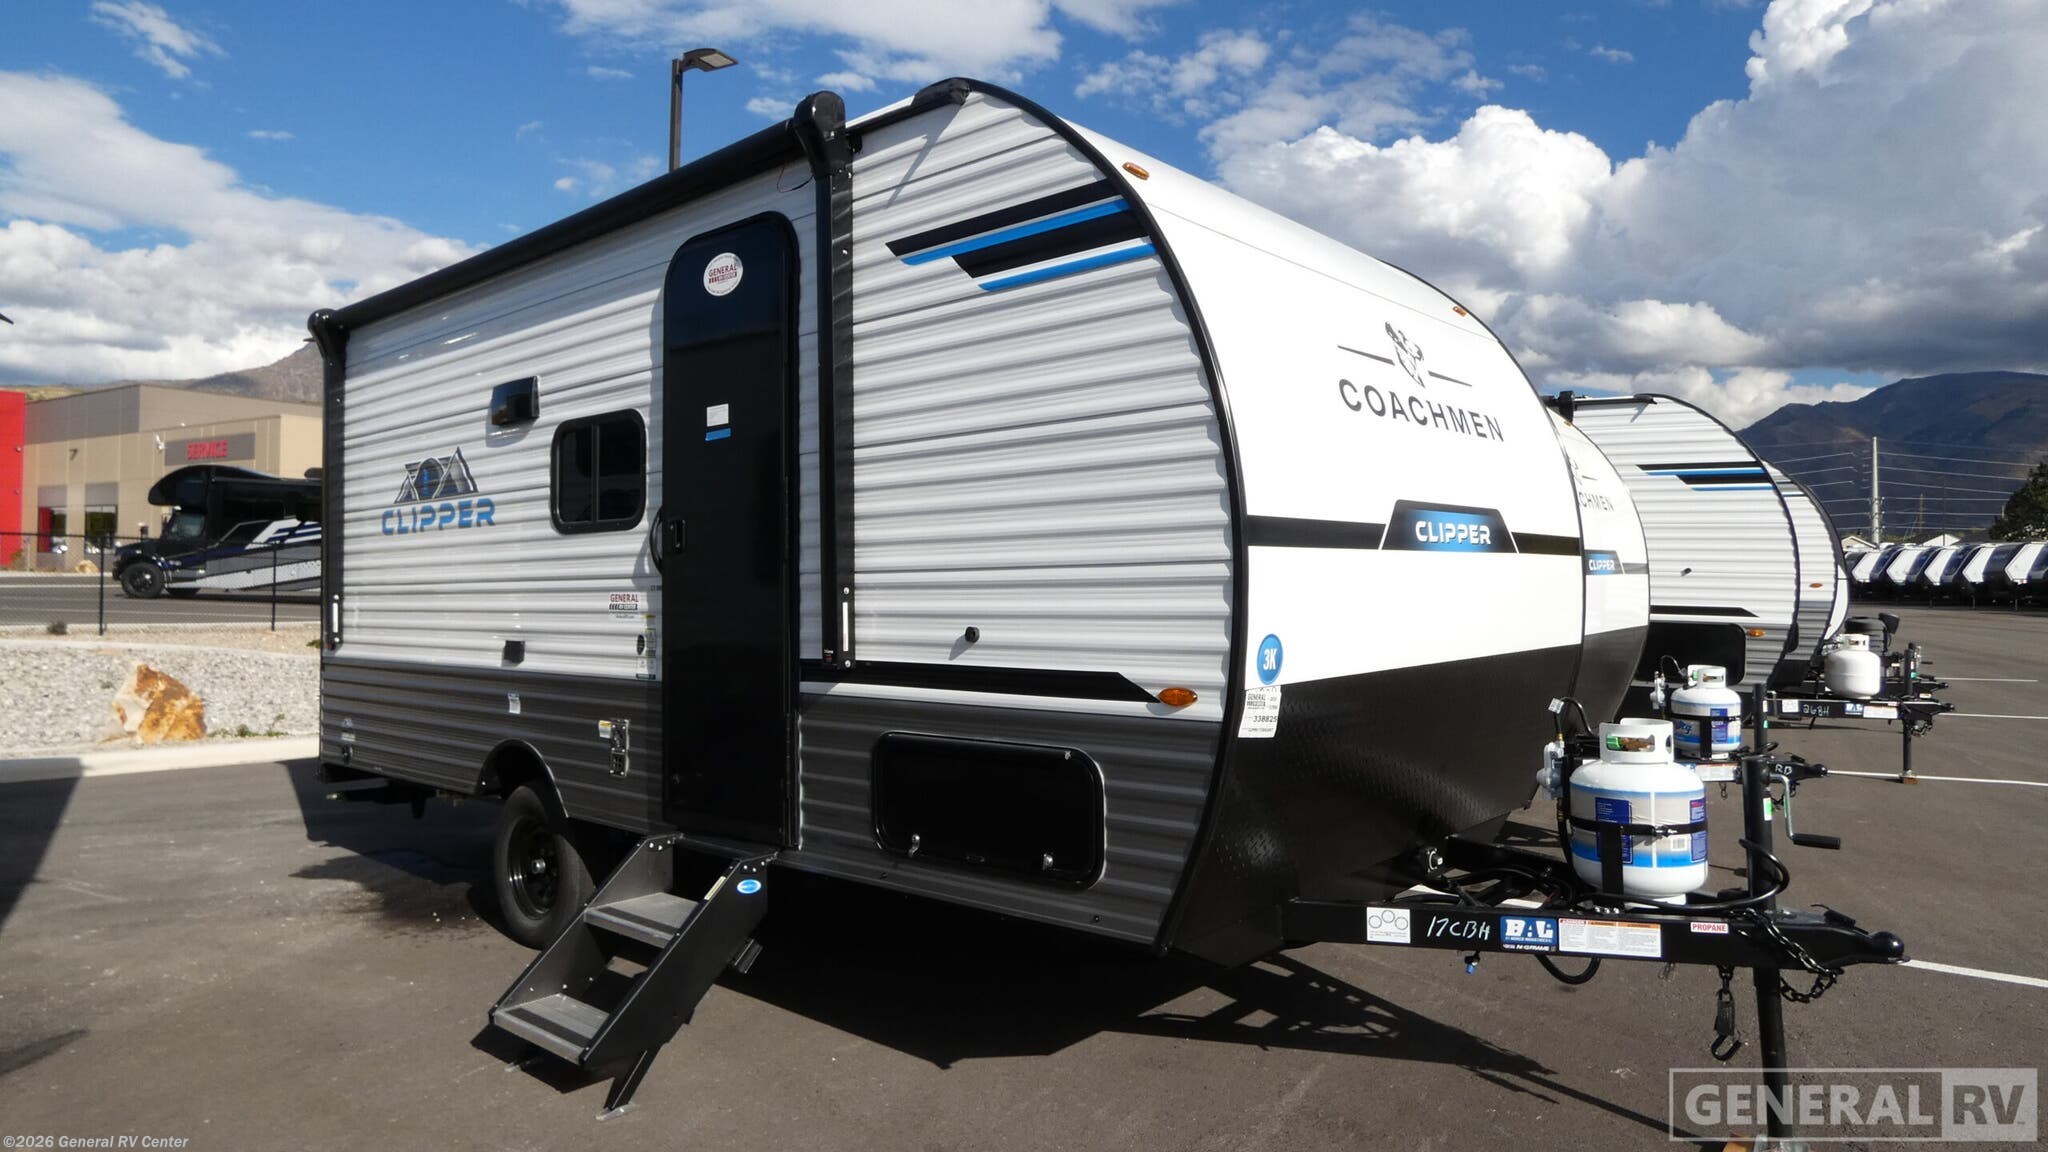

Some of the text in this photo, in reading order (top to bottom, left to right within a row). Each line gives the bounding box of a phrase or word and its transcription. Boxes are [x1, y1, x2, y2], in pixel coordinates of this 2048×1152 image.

[708, 264, 737, 277] GENERAL
[1339, 379, 1504, 442] COACHMEN
[187, 440, 229, 460] SERVICE
[1578, 491, 1615, 513] CHMEN
[381, 498, 496, 535] CLIPPER
[1415, 521, 1492, 545] CLIPPER
[1588, 559, 1615, 571] CLIPPER
[610, 594, 639, 602] GENERAL
[1263, 648, 1278, 670] 3K
[1426, 915, 1491, 941] 17CBH
[1505, 919, 1553, 938] BAL
[1692, 923, 1727, 932] PROPANE
